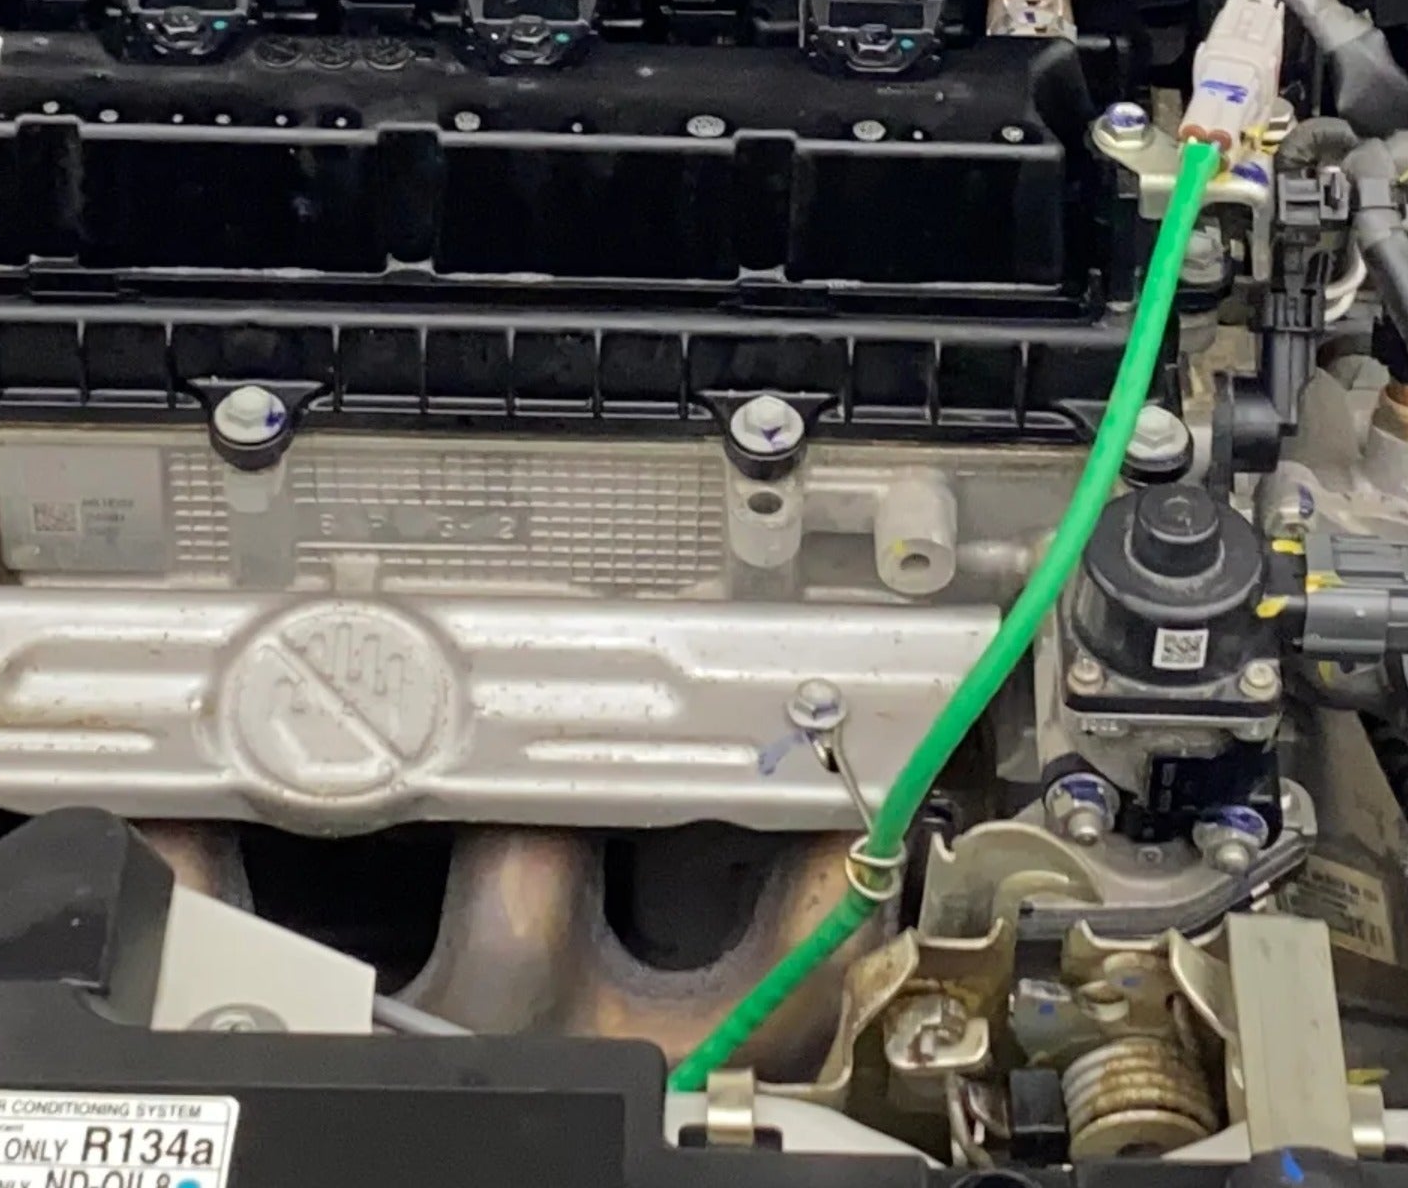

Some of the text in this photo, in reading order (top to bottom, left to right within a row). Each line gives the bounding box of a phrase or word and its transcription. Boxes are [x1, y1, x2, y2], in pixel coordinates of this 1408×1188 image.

[11, 1099, 130, 1117] CONDITIONING
[136, 1102, 202, 1118] SYSTEM
[4, 1137, 69, 1162] ONLY
[81, 1125, 214, 1165] R134a
